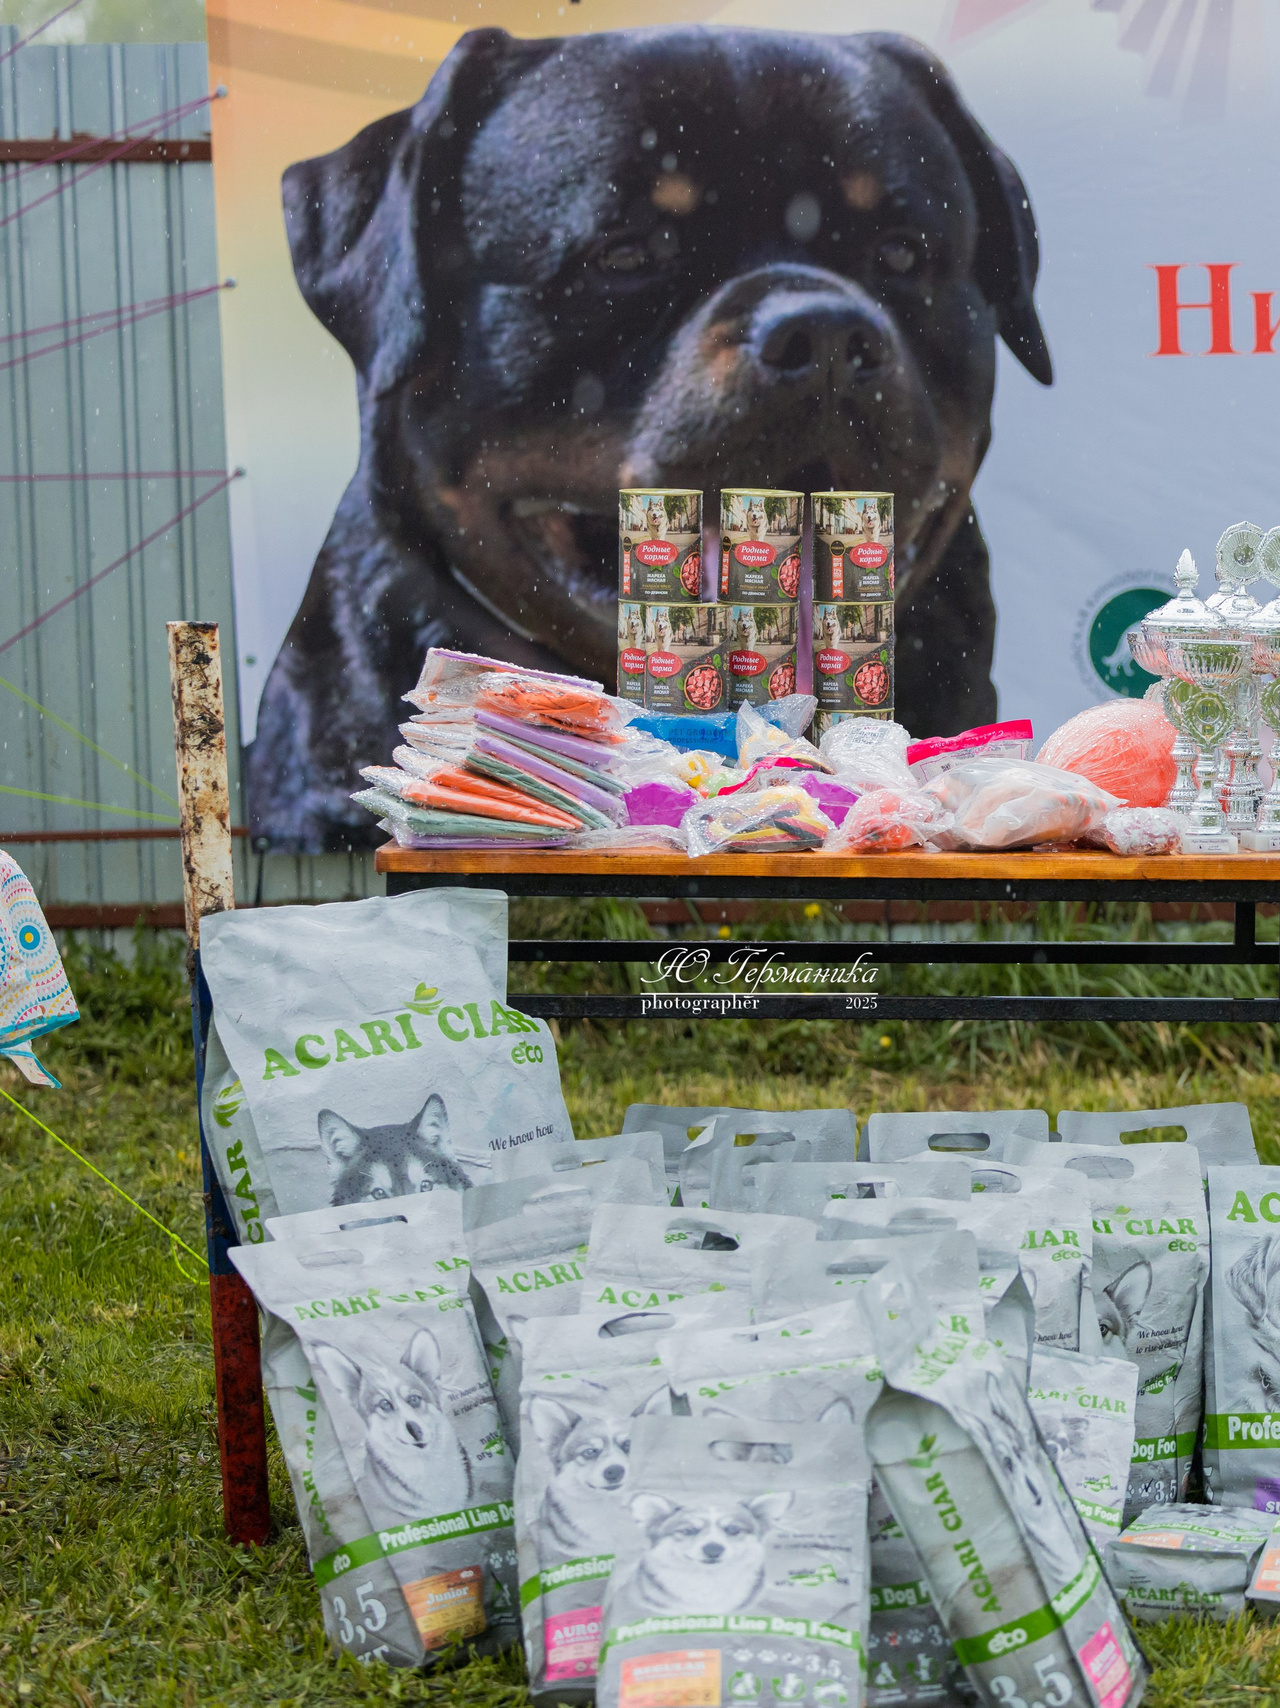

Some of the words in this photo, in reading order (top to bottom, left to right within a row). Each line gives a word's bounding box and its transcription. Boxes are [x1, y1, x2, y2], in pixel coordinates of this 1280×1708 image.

[642, 545, 671, 554] Родные
[644, 554, 669, 562] корма
[741, 545, 770, 555] Родные
[743, 553, 767, 563] корма
[857, 547, 883, 555] Родные
[624, 653, 646, 661] Родные
[732, 655, 759, 664] Родные
[819, 653, 843, 662] Родные
[652, 665, 672, 673] корма
[733, 663, 757, 671] корма
[669, 728, 684, 736] PET
[262, 1013, 422, 1081] ACARI
[436, 999, 541, 1042] CIAR
[511, 1040, 544, 1066] eco
[488, 1136, 507, 1152] We
[509, 1132, 535, 1149] know
[536, 1123, 554, 1140] how
[228, 1139, 265, 1244] CIAR
[1125, 1218, 1198, 1236] CIAR
[1168, 1237, 1197, 1253] eco
[1051, 1249, 1082, 1263] eco
[496, 1262, 585, 1294] ACARI
[294, 1295, 382, 1322] ACARI
[1137, 1329, 1150, 1339] We
[1150, 1327, 1171, 1338] know
[1171, 1323, 1184, 1334] how
[1077, 1394, 1127, 1414] CIAR
[1131, 1440, 1157, 1460] Dog
[1157, 1438, 1177, 1454] Foo
[1155, 1479, 1177, 1504] 3,5
[1093, 1506, 1120, 1523] Food
[378, 1510, 470, 1552] Professional
[468, 1508, 499, 1528] Line
[498, 1503, 515, 1521] Do
[925, 1471, 962, 1532] CIAR
[954, 1539, 1002, 1612] ACARI
[426, 1586, 470, 1605] Junior
[882, 1588, 917, 1606] Dog
[1125, 1585, 1177, 1601] ACARI
[1183, 1589, 1224, 1604] CIAR
[334, 1581, 388, 1645] 3,5
[1132, 1601, 1171, 1611] Professional
[553, 1622, 602, 1641] AURO
[616, 1615, 724, 1641] Professional
[728, 1615, 767, 1631] Line
[771, 1617, 807, 1635] Dog
[809, 1621, 853, 1644] Food
[988, 1628, 1028, 1654] eco
[805, 1654, 842, 1679] 3,5
[990, 1655, 1072, 1708] 3,5
